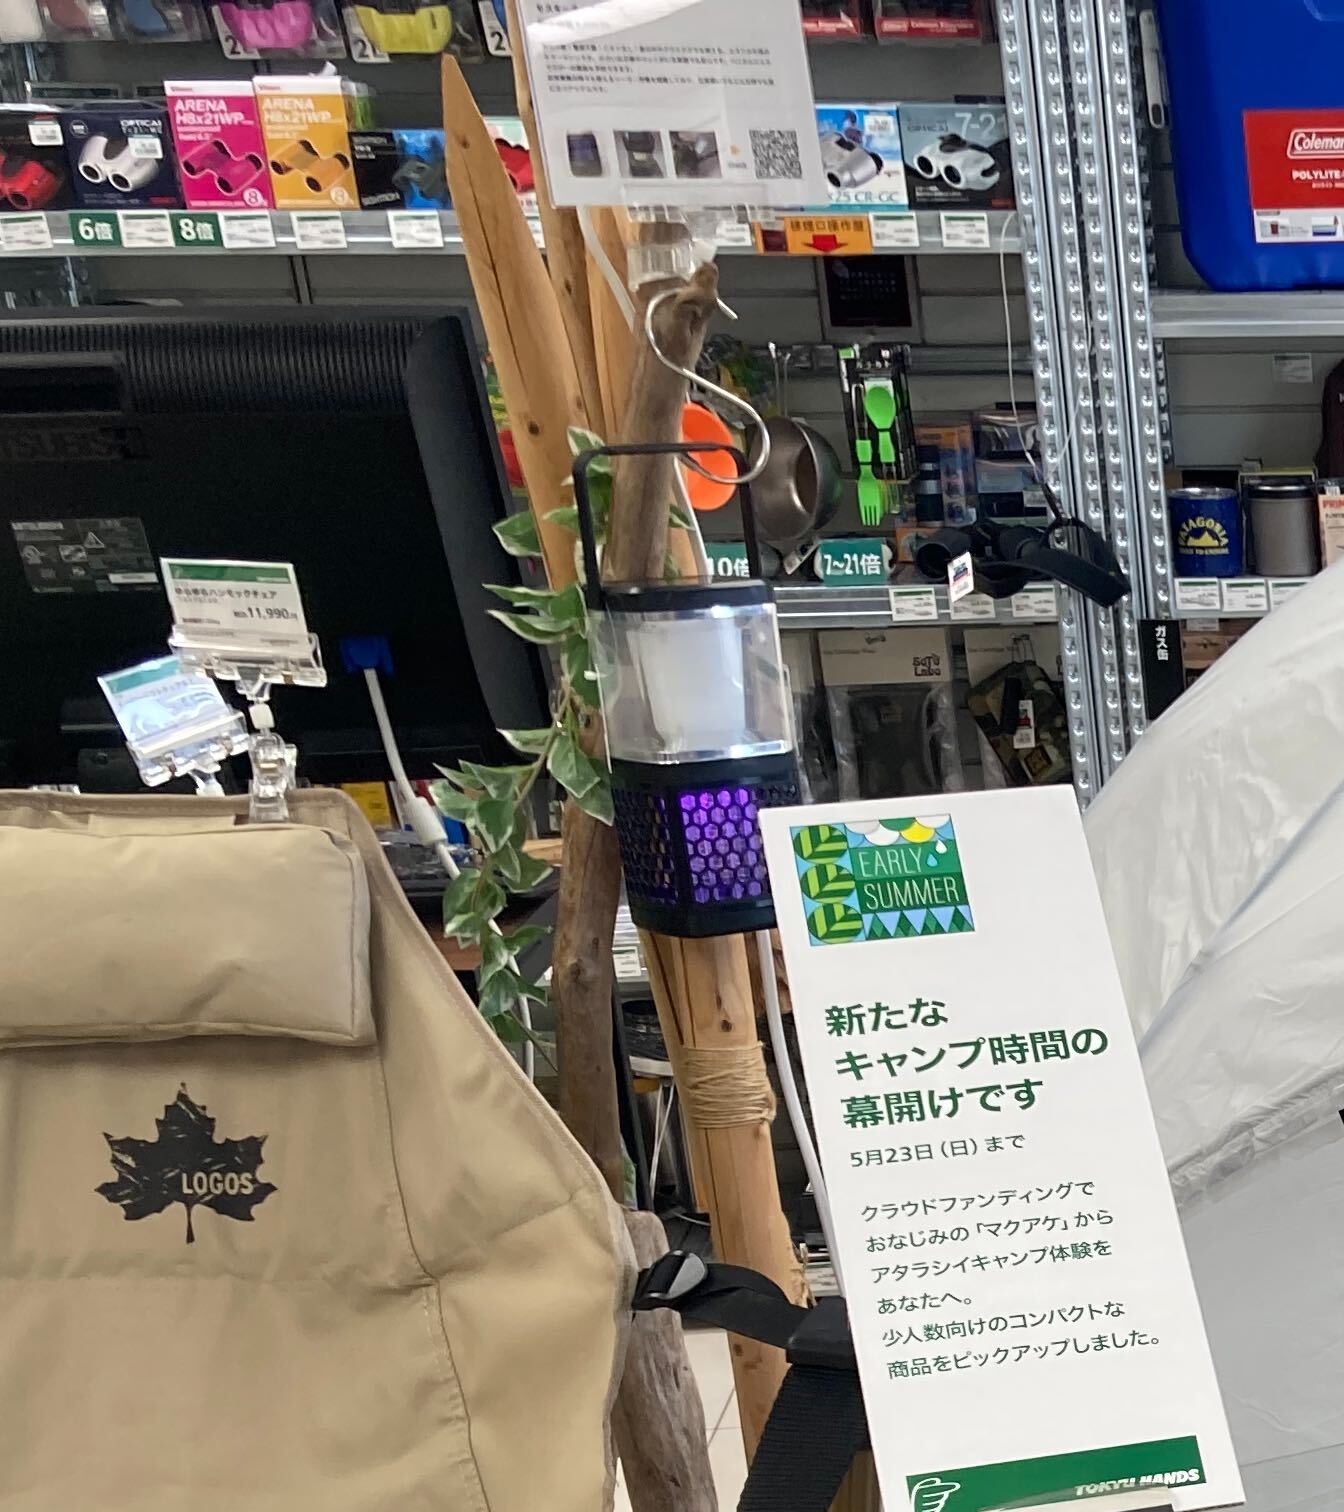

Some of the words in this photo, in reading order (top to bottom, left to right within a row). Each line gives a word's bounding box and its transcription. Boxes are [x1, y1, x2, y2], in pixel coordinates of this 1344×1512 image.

[175, 99, 228, 112] ARENA
[78, 218, 114, 242] 6倍
[179, 218, 215, 241] 8倍
[1154, 626, 1170, 662] ガス缶
[858, 847, 924, 878] EARLY
[863, 876, 960, 911] SUMMER
[825, 998, 948, 1037] 新たな
[835, 1027, 1109, 1081] キャンプ時間の
[841, 1078, 1044, 1130] 幕開けです
[182, 1172, 255, 1195] LOGOS
[860, 1180, 1095, 1224] クラウドファンディングで
[865, 1209, 1114, 1253] おなじみの「マクアケ」から
[870, 1240, 1113, 1284] アタラシイキャンプ体験を
[877, 1291, 972, 1316] あなたへ。
[881, 1300, 1125, 1347] 少人数向けのコンパクトな
[886, 1329, 1160, 1380] 商品をピックアップしました。
